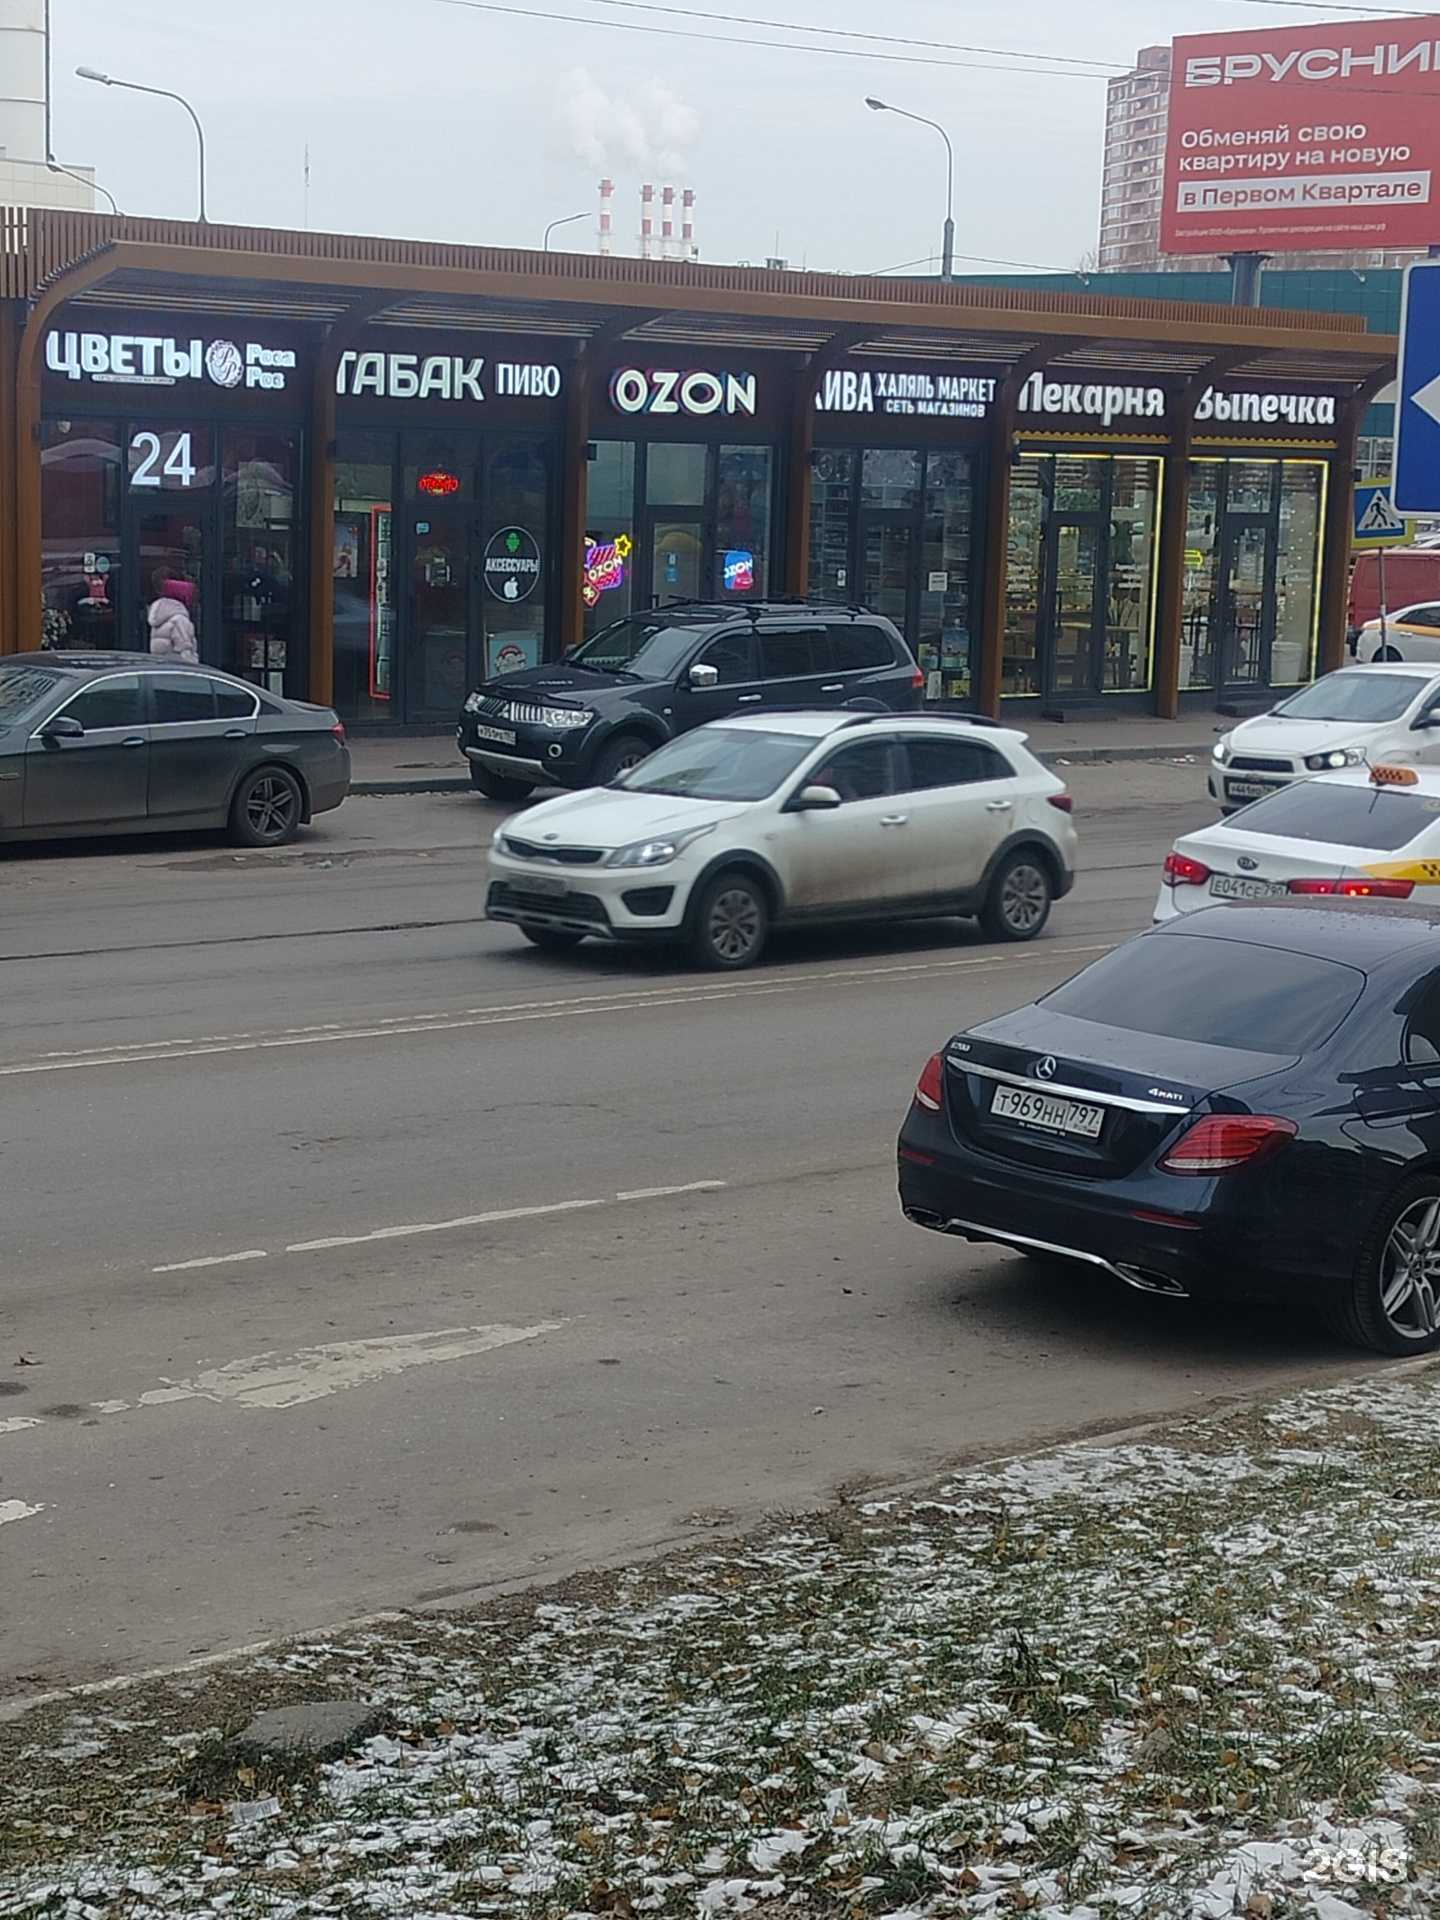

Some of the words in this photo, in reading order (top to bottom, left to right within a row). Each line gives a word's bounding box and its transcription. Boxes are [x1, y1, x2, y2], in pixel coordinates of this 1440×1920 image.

[1181, 124, 1289, 148] Обменяй
[1298, 123, 1366, 142] свою
[1179, 151, 1290, 173] квартиру
[1296, 149, 1324, 166] на
[1331, 146, 1410, 166] новую
[1184, 191, 1195, 206] в
[1202, 187, 1295, 207] Первом
[1302, 182, 1421, 203] Квартале
[46, 331, 202, 379] ЦВЕТЫ
[246, 343, 296, 367] Роза
[246, 366, 285, 389] Роз
[496, 363, 561, 397] ПИВО
[876, 373, 935, 398] ХАЛЯЛЬ
[938, 376, 996, 402] МАРКЕТ
[614, 368, 756, 415] OZON
[815, 370, 873, 412] ИВА
[886, 400, 914, 414] СЕТЬ
[917, 401, 986, 418] МАГАЗИНОВ
[130, 431, 196, 487] 24
[485, 557, 540, 573] АКСЕССУАРЫ
[588, 556, 623, 581] OZON
[1069, 1103, 1099, 1126] 797
